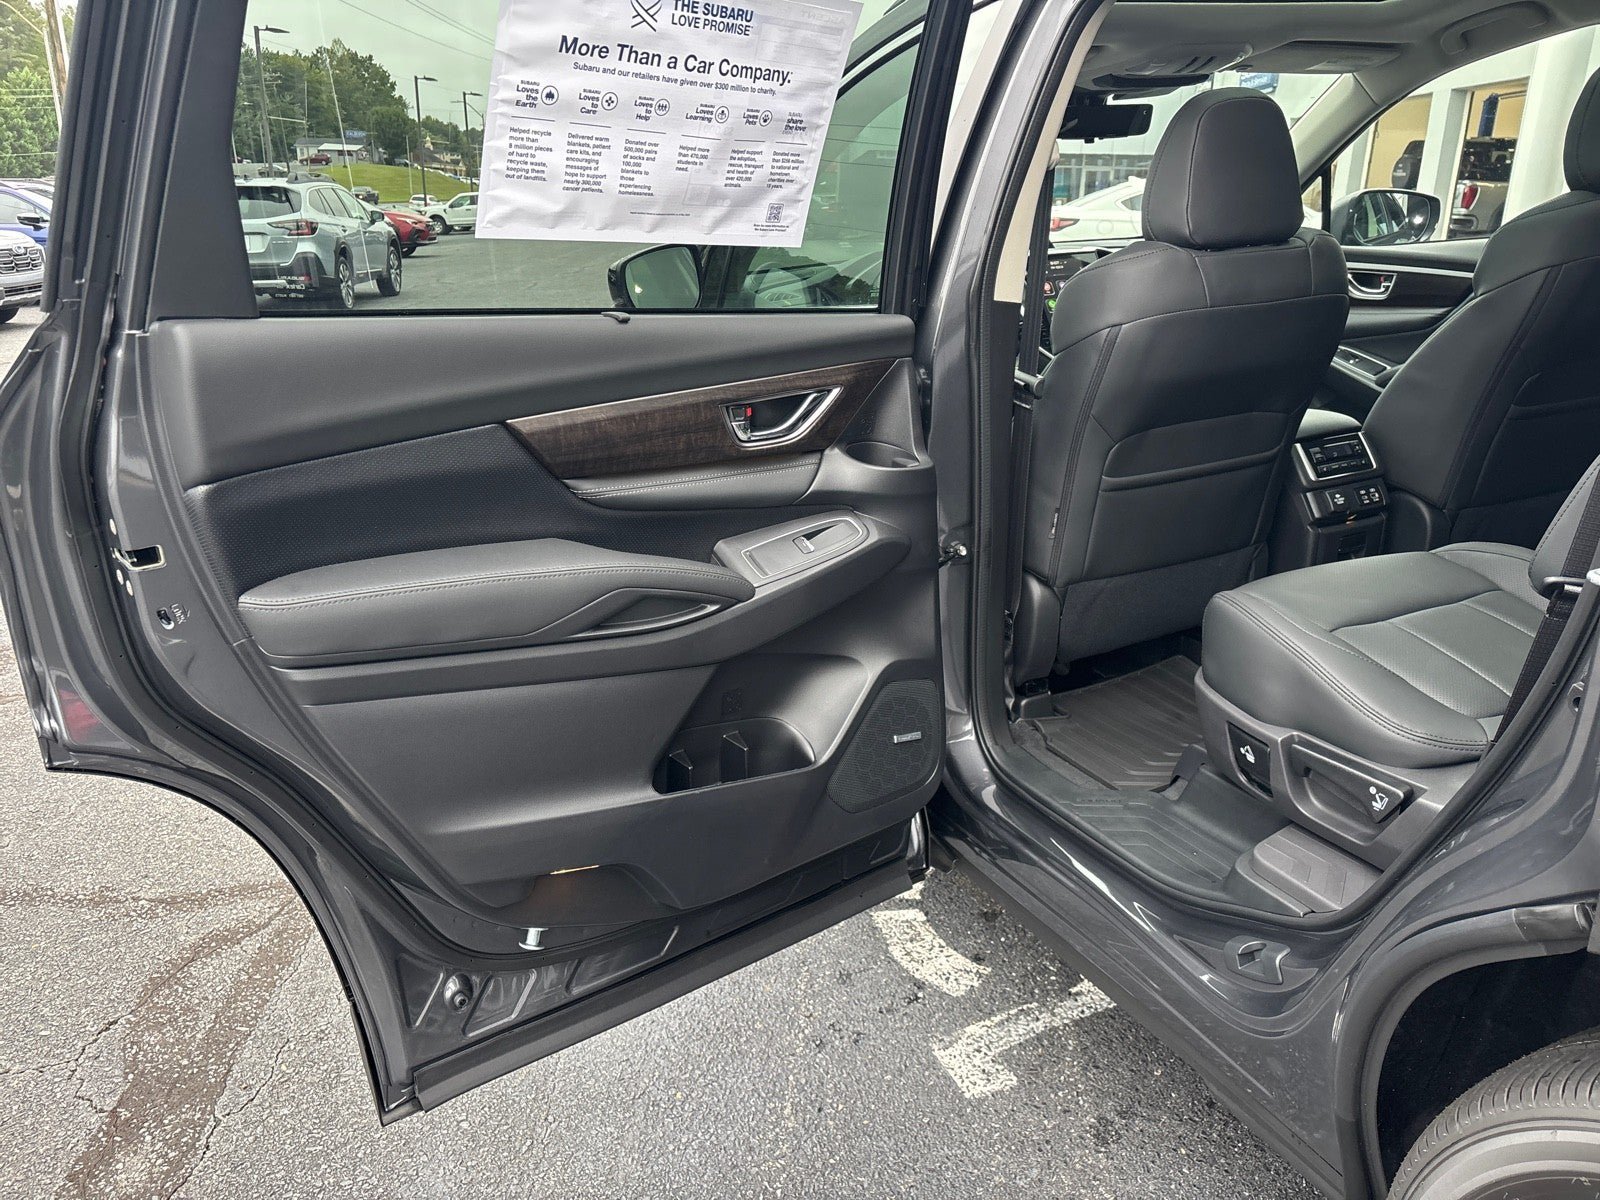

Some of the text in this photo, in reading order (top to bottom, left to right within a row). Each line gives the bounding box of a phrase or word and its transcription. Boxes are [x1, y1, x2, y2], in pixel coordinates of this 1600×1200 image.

[674, 0, 753, 22] THE SUBARU
[671, 13, 750, 36] LOVE PROMISE
[559, 35, 609, 58] More
[617, 43, 661, 67] Than
[667, 56, 678, 69] a
[684, 55, 714, 74] Car
[573, 62, 600, 72] Subaru
[632, 71, 660, 81] retailers
[680, 78, 697, 86] given
[715, 82, 728, 90] $300
[730, 84, 749, 92] million
[757, 88, 776, 96] charity.
[516, 85, 539, 94] Loves
[579, 93, 599, 101] Loves
[515, 100, 536, 108] Earth
[634, 100, 653, 108] Loves
[696, 108, 714, 116] Loves
[686, 113, 713, 123] Learning
[532, 129, 551, 137] recycle
[506, 166, 529, 174] keeping
